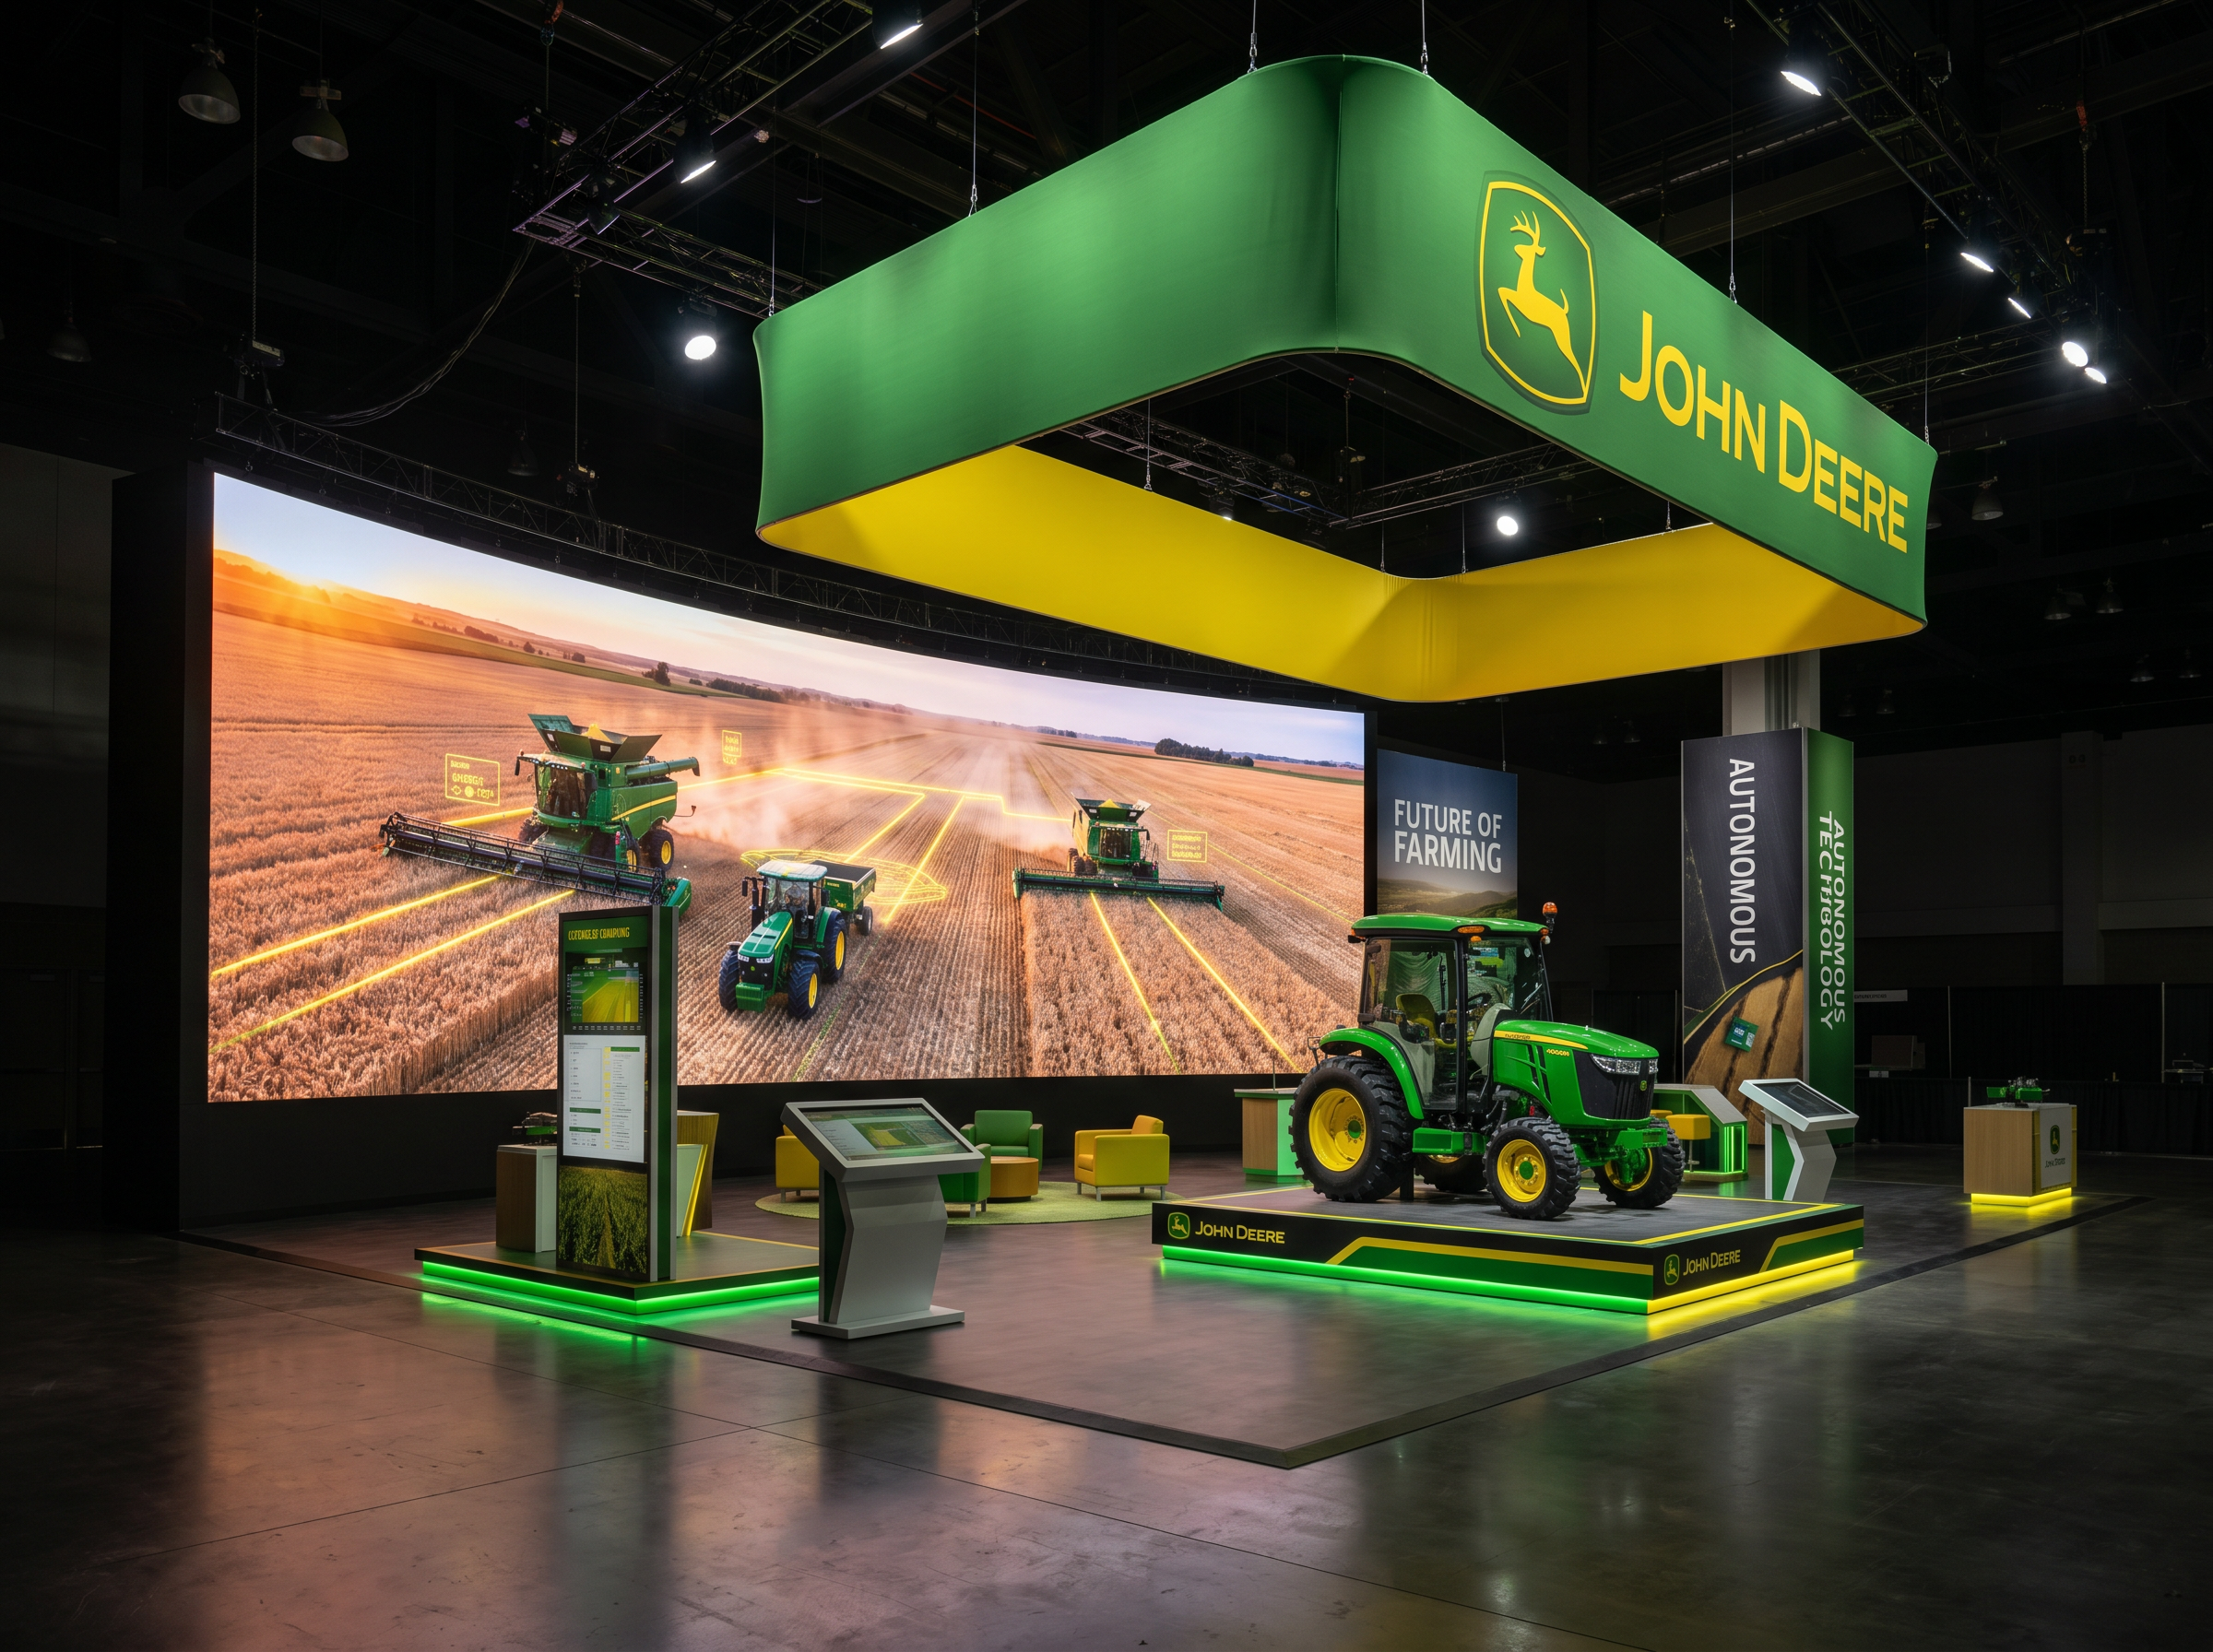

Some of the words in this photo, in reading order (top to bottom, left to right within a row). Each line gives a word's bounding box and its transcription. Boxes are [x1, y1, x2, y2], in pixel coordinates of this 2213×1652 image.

[1619, 311, 1766, 473] JOHN
[1779, 399, 1909, 553] DEERE
[1394, 798, 1473, 836] FUTURE
[1477, 812, 1503, 839] OF
[1394, 830, 1502, 874] FARMING
[1729, 758, 1756, 964] AUTONOMOUS
[1833, 819, 1846, 1023] AUTONOMOUS
[1195, 1221, 1234, 1239] JOHN
[1237, 1224, 1285, 1245] DEERE
[1683, 1257, 1710, 1276] JOHN
[1710, 1249, 1741, 1269] DEERE
